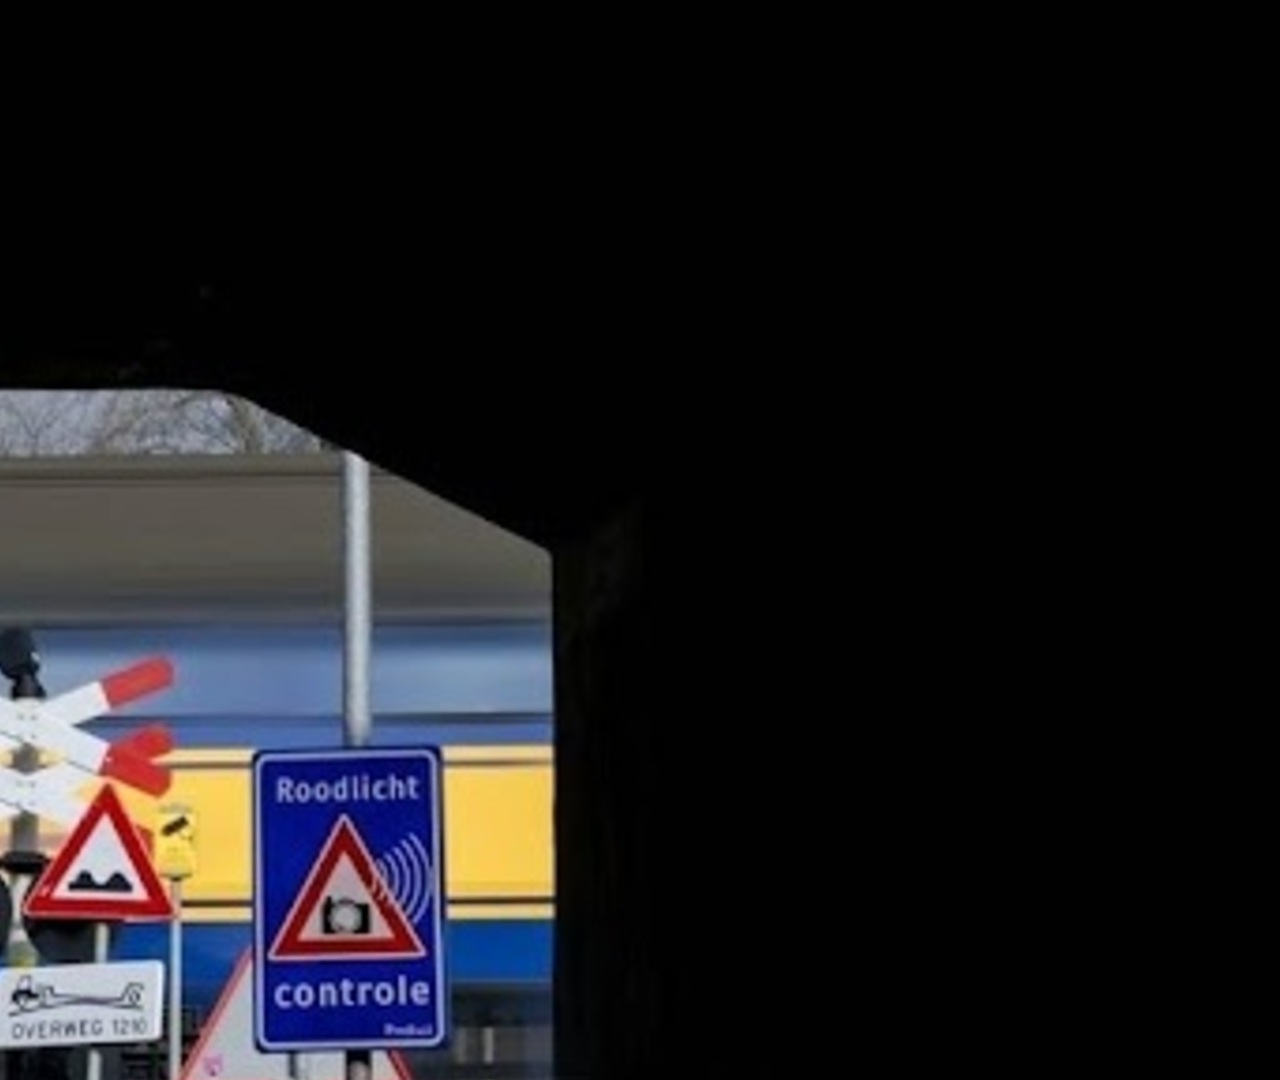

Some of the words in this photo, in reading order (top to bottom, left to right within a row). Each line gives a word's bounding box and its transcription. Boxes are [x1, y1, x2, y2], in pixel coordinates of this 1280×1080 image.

[276, 774, 419, 803] Roodlicht
[274, 974, 430, 1009] controle
[11, 1020, 103, 1040] OVERWEG
